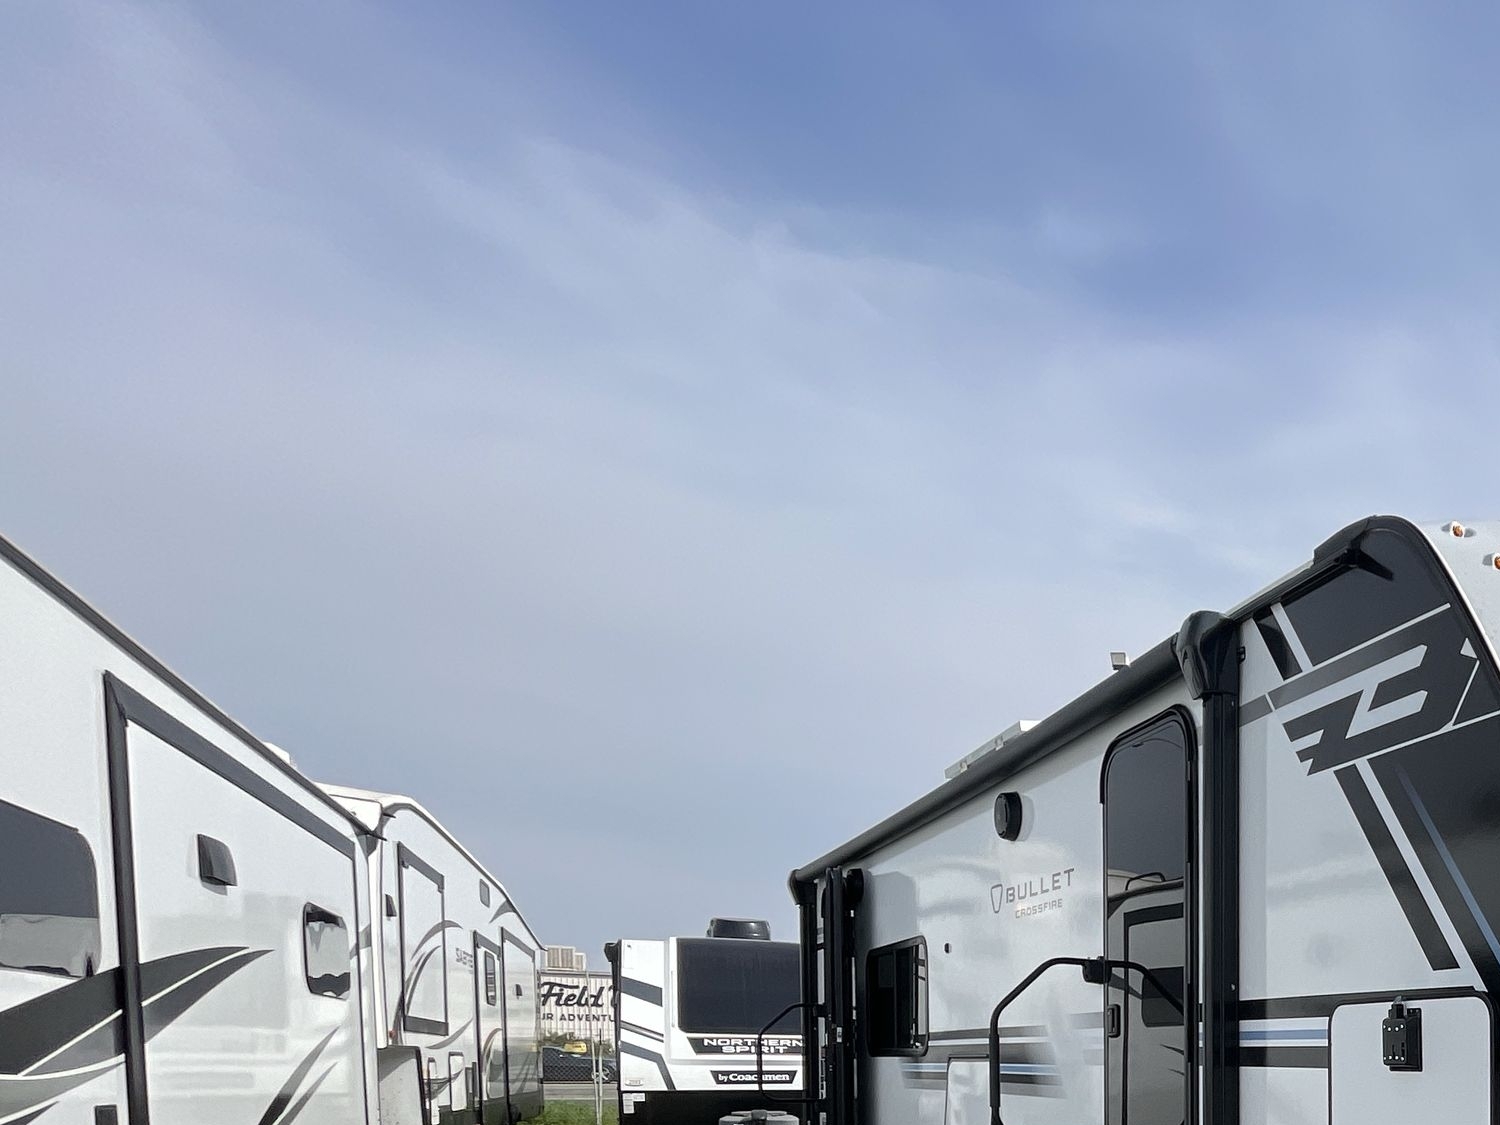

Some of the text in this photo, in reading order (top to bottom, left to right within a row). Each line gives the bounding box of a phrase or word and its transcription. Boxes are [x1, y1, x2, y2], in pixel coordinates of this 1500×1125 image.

[1005, 867, 1075, 904] BULLET
[1015, 898, 1063, 919] CROSSFIRE
[540, 981, 605, 1008] Field
[718, 1072, 790, 1083] by Coacmen
